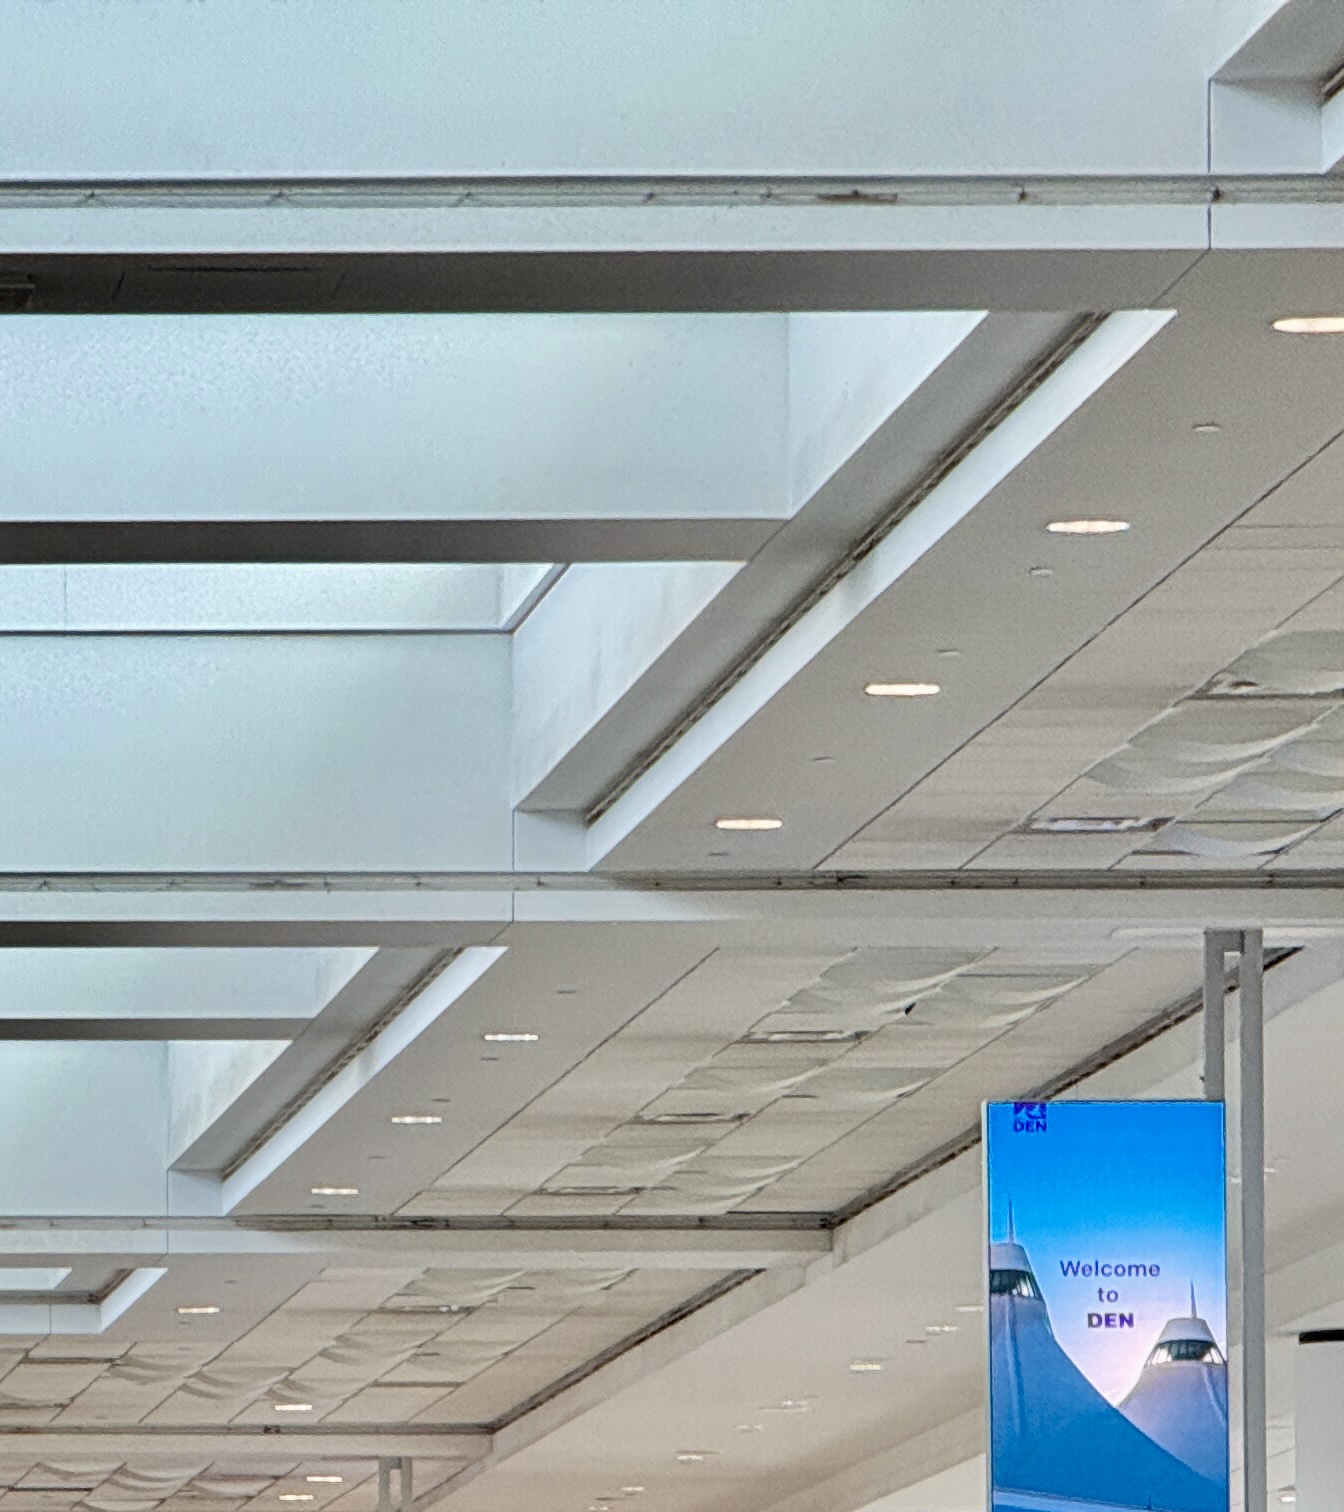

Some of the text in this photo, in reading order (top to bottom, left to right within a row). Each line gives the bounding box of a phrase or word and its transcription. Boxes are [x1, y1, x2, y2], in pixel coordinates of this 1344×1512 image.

[1013, 1119, 1048, 1134] DEN
[1059, 1259, 1162, 1278] Welcome
[1097, 1286, 1119, 1304] to
[1086, 1312, 1135, 1329] DEN
